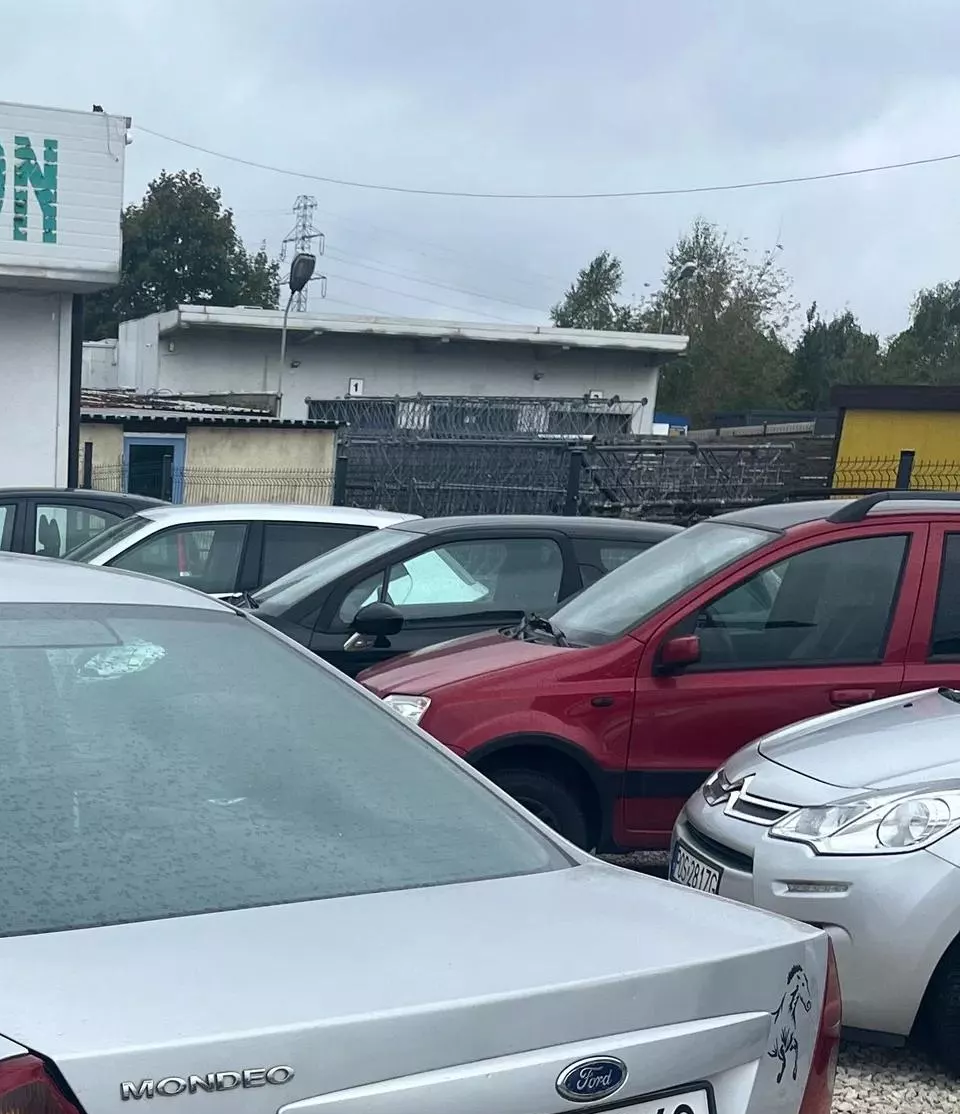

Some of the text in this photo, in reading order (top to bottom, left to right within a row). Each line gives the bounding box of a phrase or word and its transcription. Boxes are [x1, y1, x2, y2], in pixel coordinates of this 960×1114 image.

[353, 382, 359, 392] 1
[120, 1064, 295, 1100] MONDEO
[577, 1066, 612, 1091] Ford
